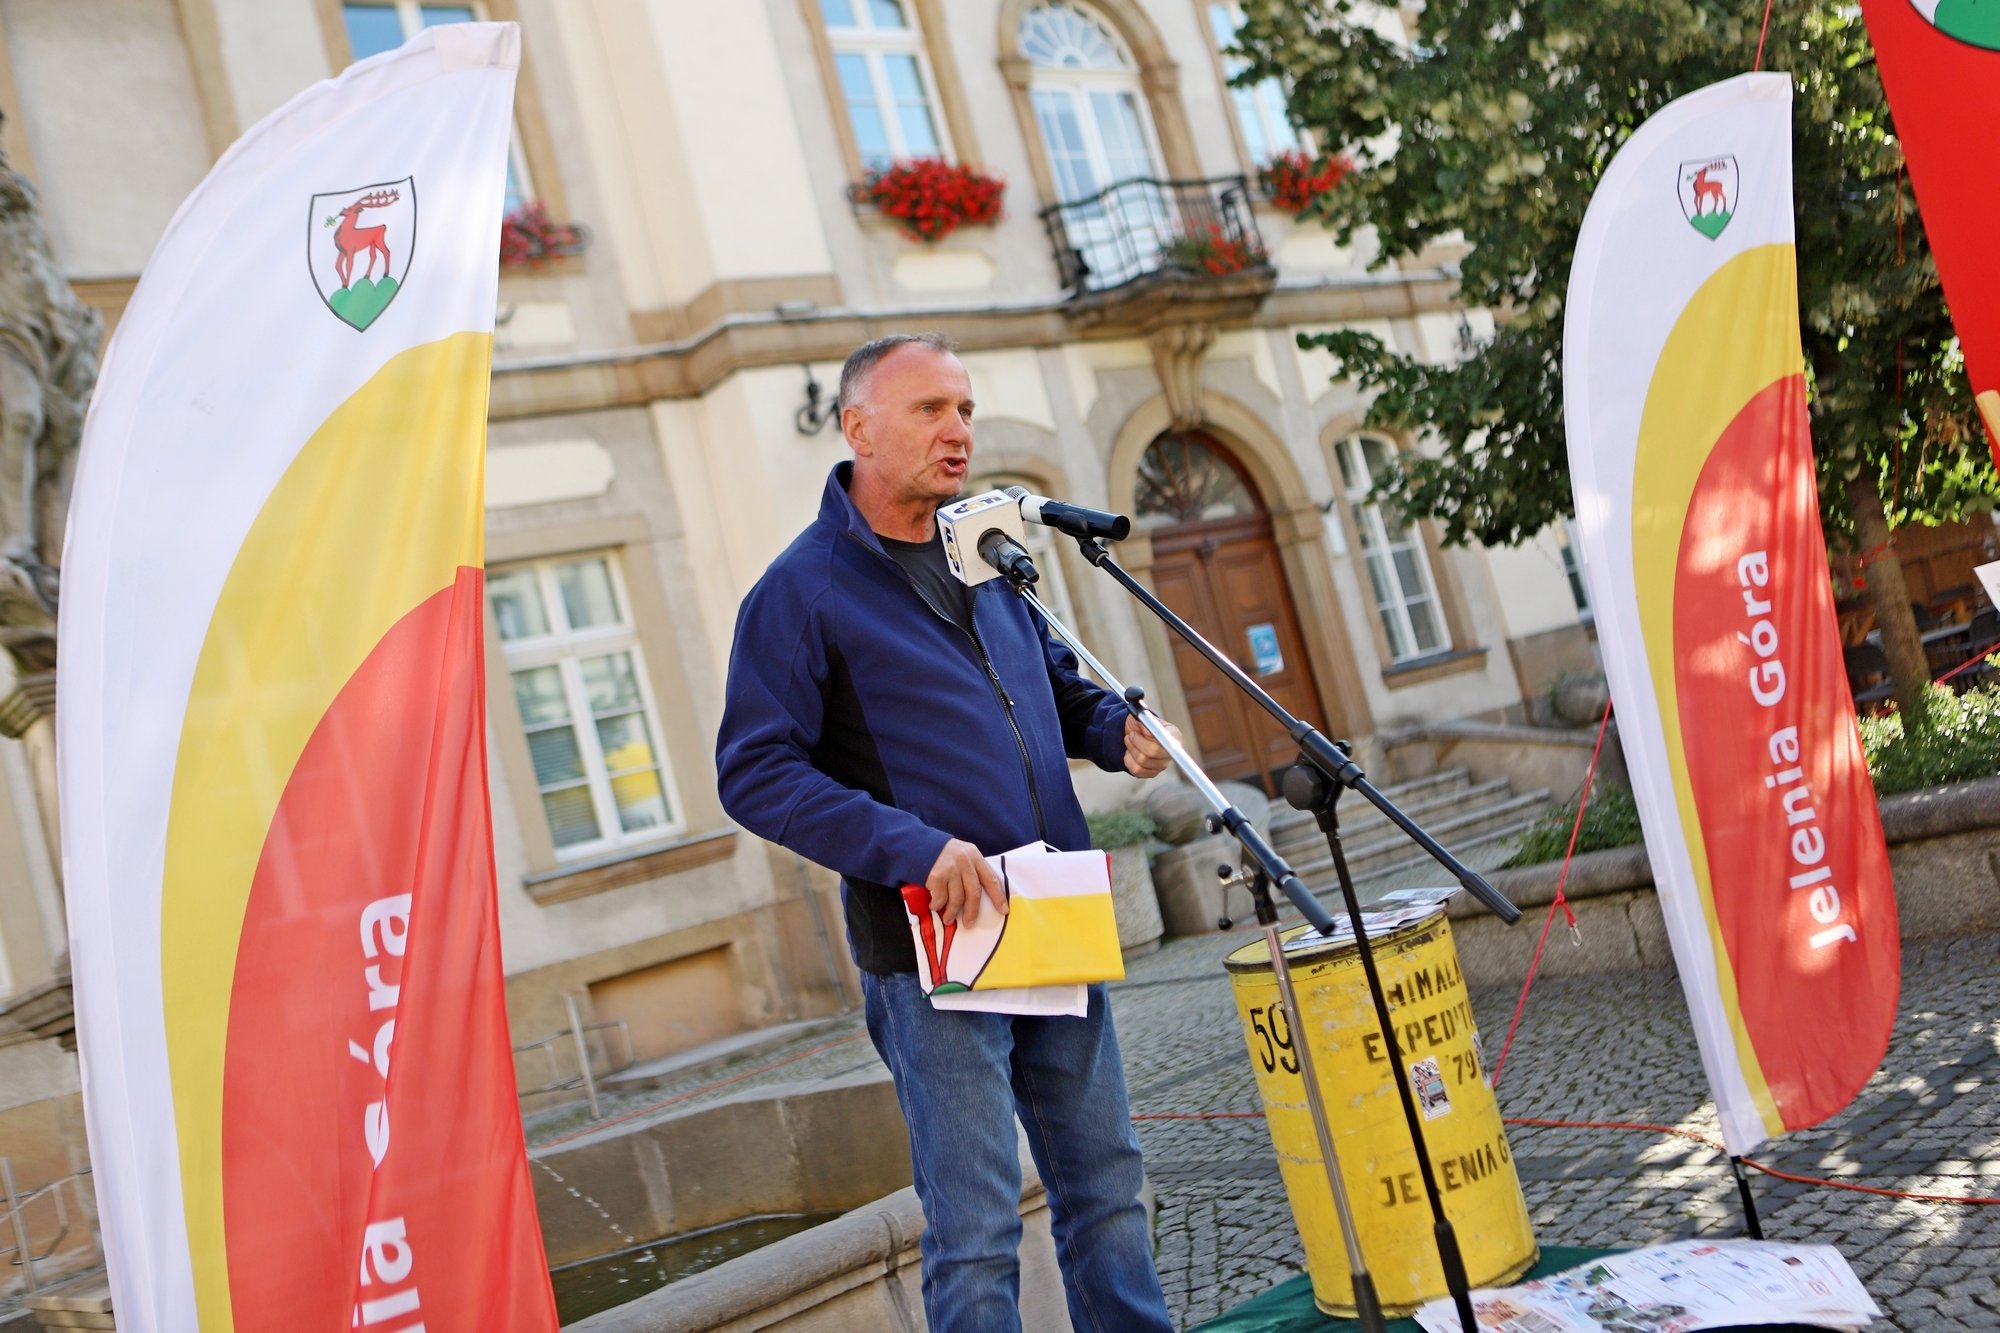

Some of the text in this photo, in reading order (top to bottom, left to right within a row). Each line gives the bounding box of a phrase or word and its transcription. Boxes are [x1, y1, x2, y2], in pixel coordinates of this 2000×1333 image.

[1737, 549, 1858, 951] Jelenia Góra
[1249, 1001, 1301, 1074] 59
[1379, 1143, 1498, 1208] JEENIA
